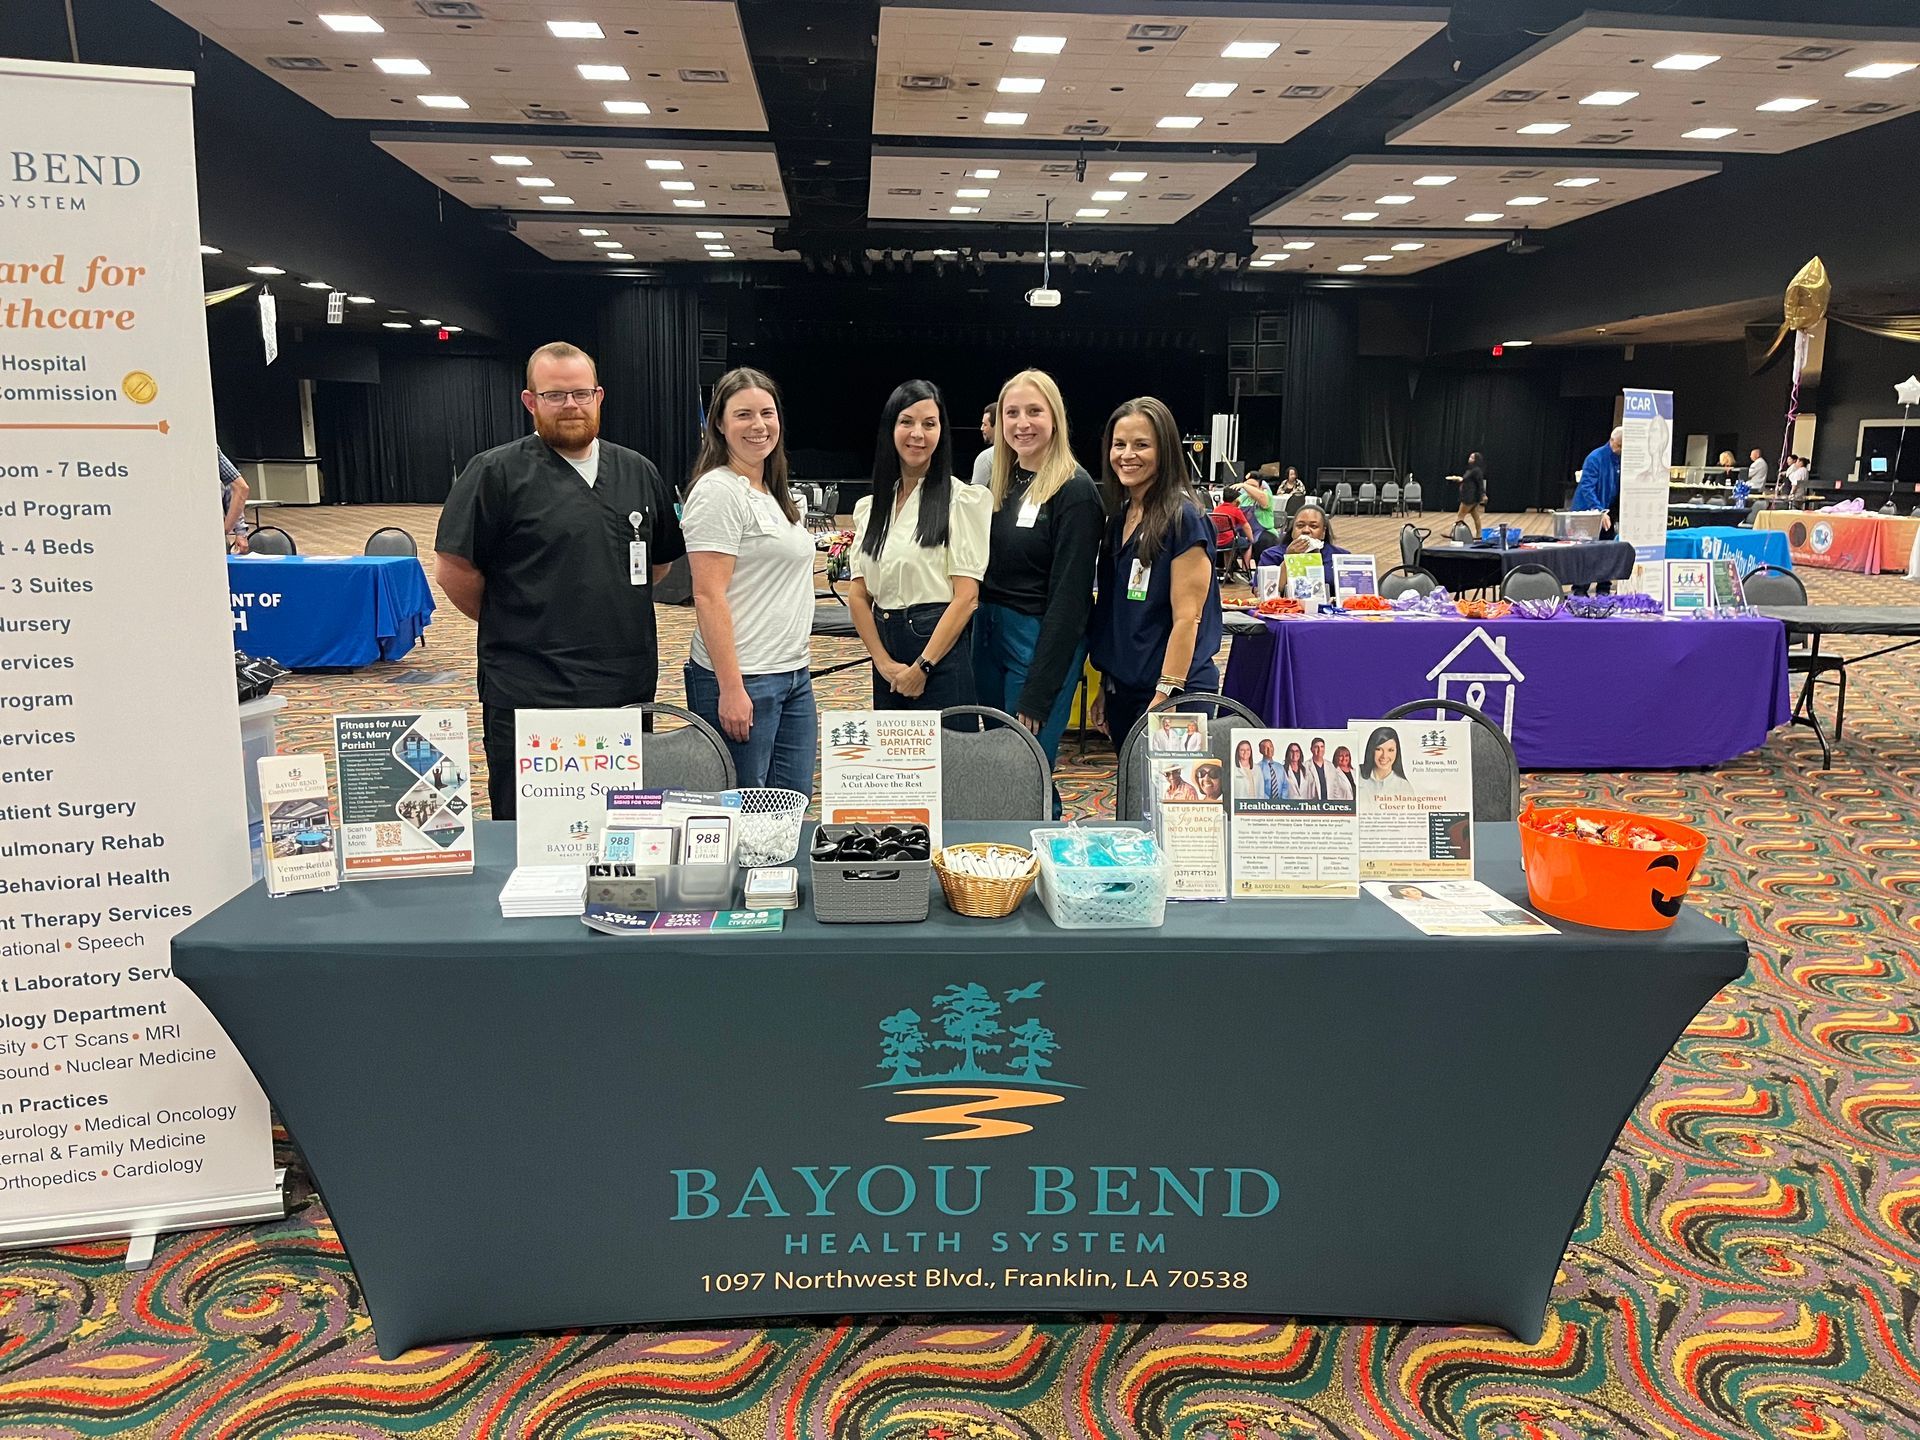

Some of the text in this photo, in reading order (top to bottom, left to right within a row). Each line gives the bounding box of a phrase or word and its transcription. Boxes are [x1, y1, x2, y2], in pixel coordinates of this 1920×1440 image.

[11, 151, 141, 186] BEND
[78, 255, 146, 293] for
[0, 298, 135, 330] thcare
[2, 355, 86, 374] Hospital
[1625, 396, 1650, 411] TCAR
[58, 462, 69, 477] 7
[77, 461, 129, 478] Beds
[24, 501, 111, 521] Program
[25, 540, 35, 555] 4
[42, 539, 94, 555] Beds
[12, 578, 23, 593] 3
[30, 577, 94, 594] Suites
[231, 593, 281, 607] NT OF
[2, 654, 74, 670] ervices
[1, 693, 73, 711] rogram
[340, 719, 407, 730] Fitness for ALL
[876, 719, 936, 727] BAYOU BEND
[0, 729, 76, 746] ervices
[341, 730, 391, 741] of St. Mary
[877, 729, 926, 737] SURGICAL
[341, 741, 376, 750] Parish!
[880, 738, 932, 746] BARIATRIC
[887, 747, 926, 755] CENTER
[520, 755, 640, 774] PEDIATRICS
[2, 767, 53, 784] enter
[841, 772, 874, 781] Surgical
[896, 772, 920, 780] That's
[521, 783, 586, 800] Coming
[1395, 795, 1447, 803] Management
[58, 800, 136, 818] Surgery
[1322, 803, 1352, 811] Cares.
[2, 832, 164, 857] ulmonary Rehab
[610, 837, 630, 845] 988
[696, 833, 720, 844] 988
[547, 843, 582, 852] BAYOU
[277, 860, 332, 874] Venue Rental
[107, 868, 170, 888] Health
[280, 870, 331, 883] Information
[21, 909, 101, 929] Therapy
[108, 904, 192, 922] Services
[591, 914, 647, 926] MATTER
[605, 911, 638, 920] YOU
[729, 911, 769, 919] 988
[0, 933, 145, 957] ational Speech
[15, 970, 121, 991] Laboratory
[54, 1001, 166, 1025] Department
[43, 1034, 68, 1051] CT
[75, 1032, 129, 1048] Scans
[146, 1024, 180, 1041] MRI
[66, 1055, 134, 1074] Nuclear
[140, 1048, 216, 1067] Medicine
[20, 1093, 108, 1113] Practices
[85, 1112, 151, 1132] Medical
[157, 1104, 237, 1124] Oncology
[0, 1132, 206, 1165] ernal & Family Medicine
[113, 1156, 204, 1179] Cardiology
[669, 1164, 1281, 1222] BAYOU BEND
[785, 1231, 1167, 1255] HEALTH SYSTEM
[701, 1268, 1249, 1292] 1097 Northwest Blvd., Franklin, LA 70538
